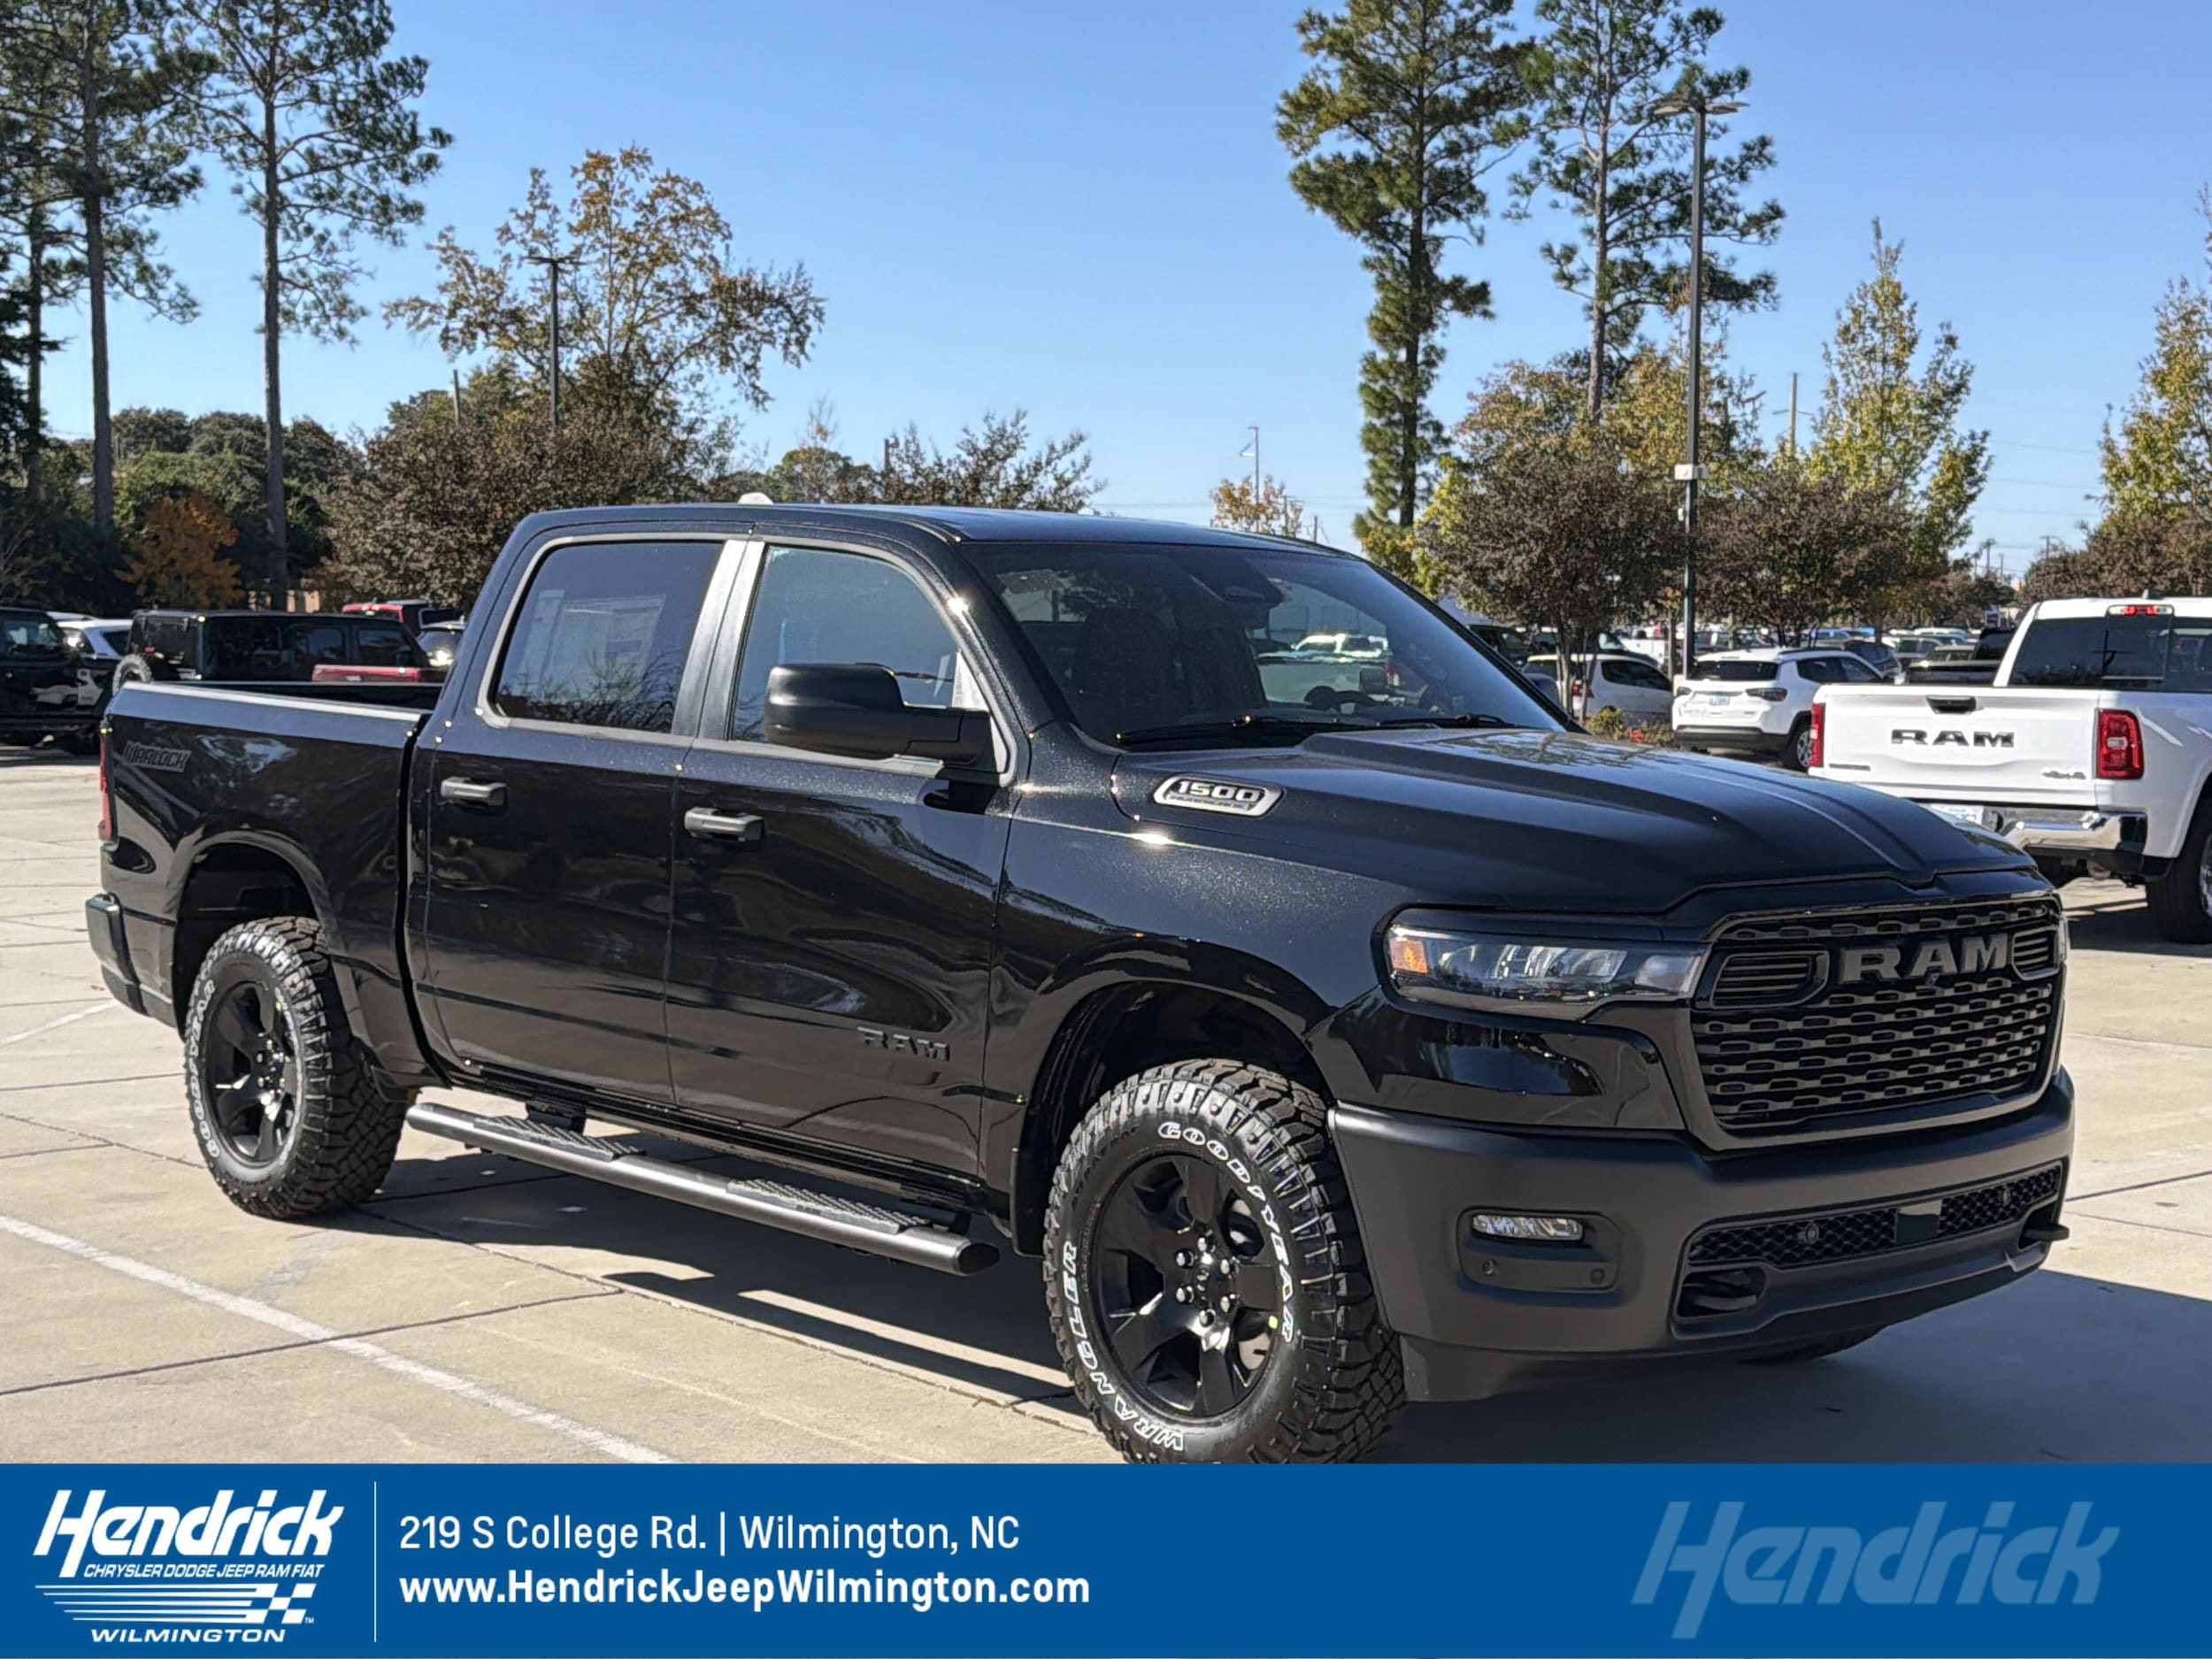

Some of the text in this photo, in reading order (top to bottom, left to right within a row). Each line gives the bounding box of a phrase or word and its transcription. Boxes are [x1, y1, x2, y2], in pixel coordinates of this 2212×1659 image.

[1891, 729, 2015, 748] RAM
[125, 743, 190, 771] WARLOCK
[1178, 780, 1262, 803] 1500
[1839, 933, 2008, 984] RAM
[856, 1026, 951, 1061] RAM
[1157, 1121, 1296, 1343] GOODYEAR
[1063, 1240, 1185, 1452] WRANGLER
